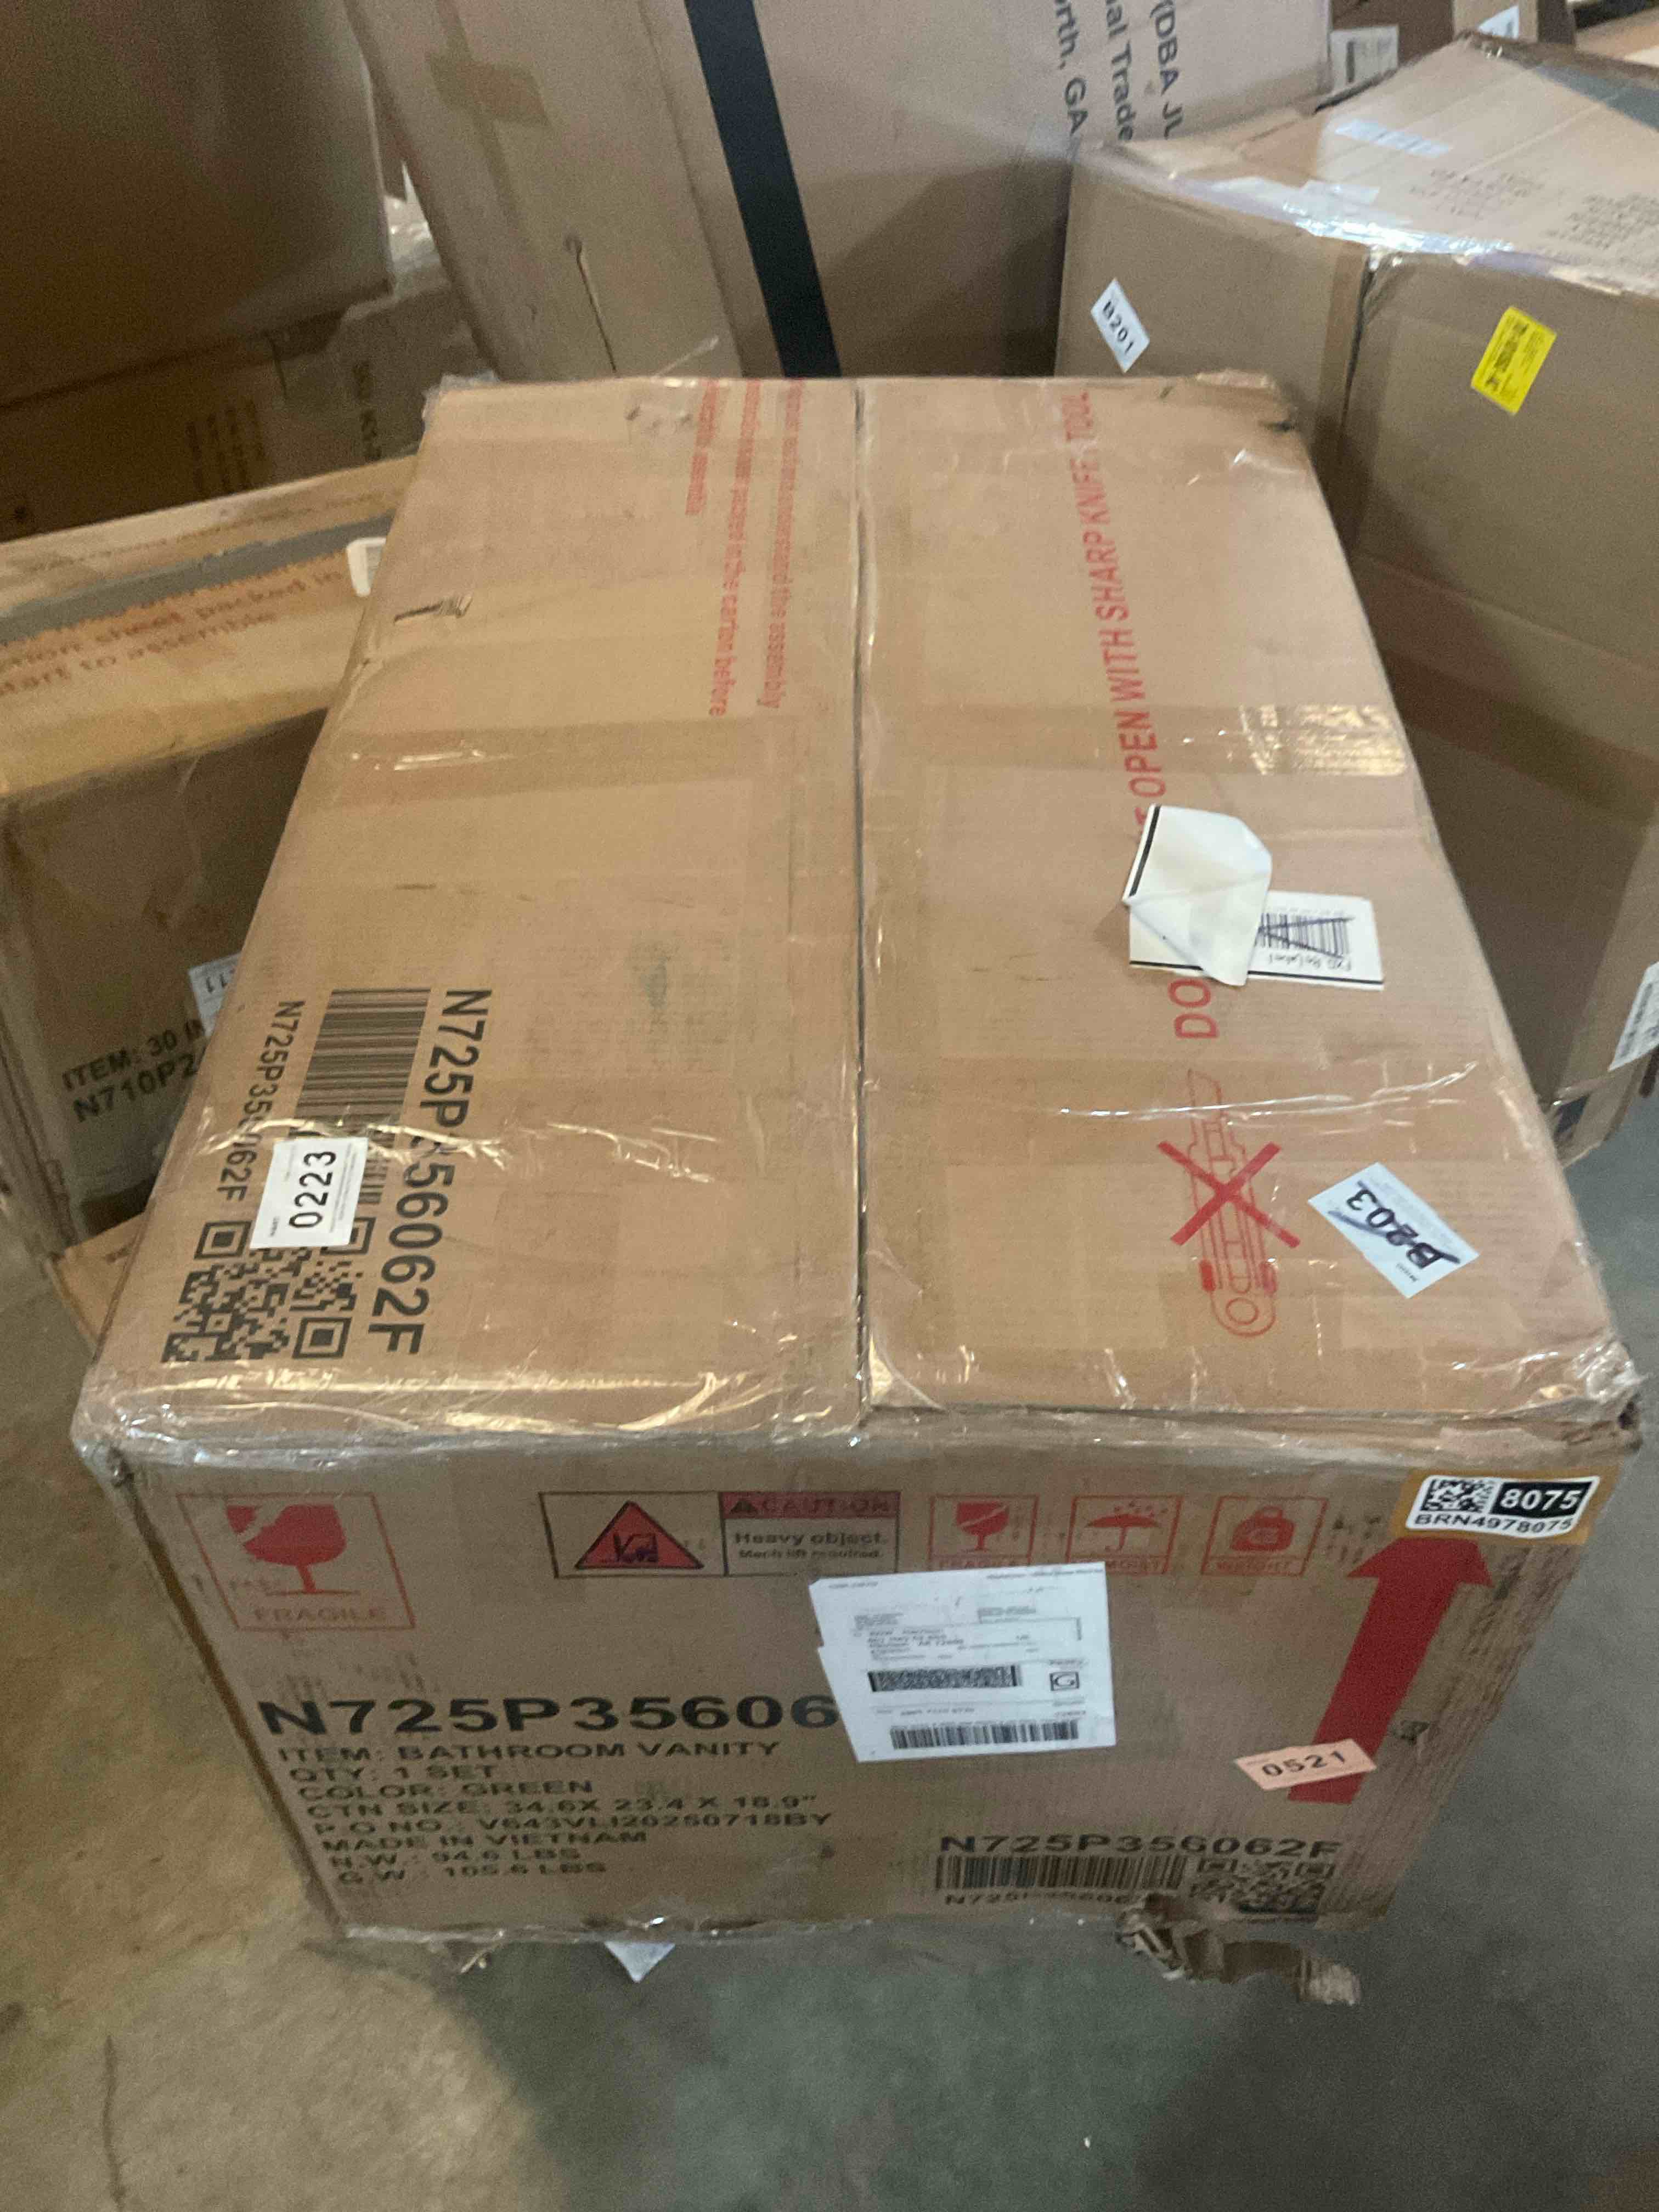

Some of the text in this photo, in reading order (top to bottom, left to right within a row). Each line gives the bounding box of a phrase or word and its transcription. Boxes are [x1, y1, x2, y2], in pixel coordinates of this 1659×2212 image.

[1105, 0, 1128, 37] al
[1056, 0, 1088, 135] rth, GA
[1103, 300, 1134, 355] B201
[1082, 531, 1130, 620] SHARP
[1099, 628, 1146, 702] WITH
[1115, 710, 1166, 798] OPEN
[1168, 977, 1219, 1039] DO
[61, 1047, 141, 1092] ITEM:
[145, 1029, 178, 1057] 30
[73, 1052, 198, 1122] N710P2
[288, 1151, 336, 1228] 0223
[1415, 1513, 1573, 1534] BRN4978075
[1499, 1488, 1581, 1510] 8075
[735, 1532, 803, 1547] Heavy
[397, 1743, 624, 1760] BATHROOM
[636, 1741, 781, 1757] VANITY
[461, 1780, 592, 1797] GREEN
[485, 1832, 647, 1846] VIETNAM
